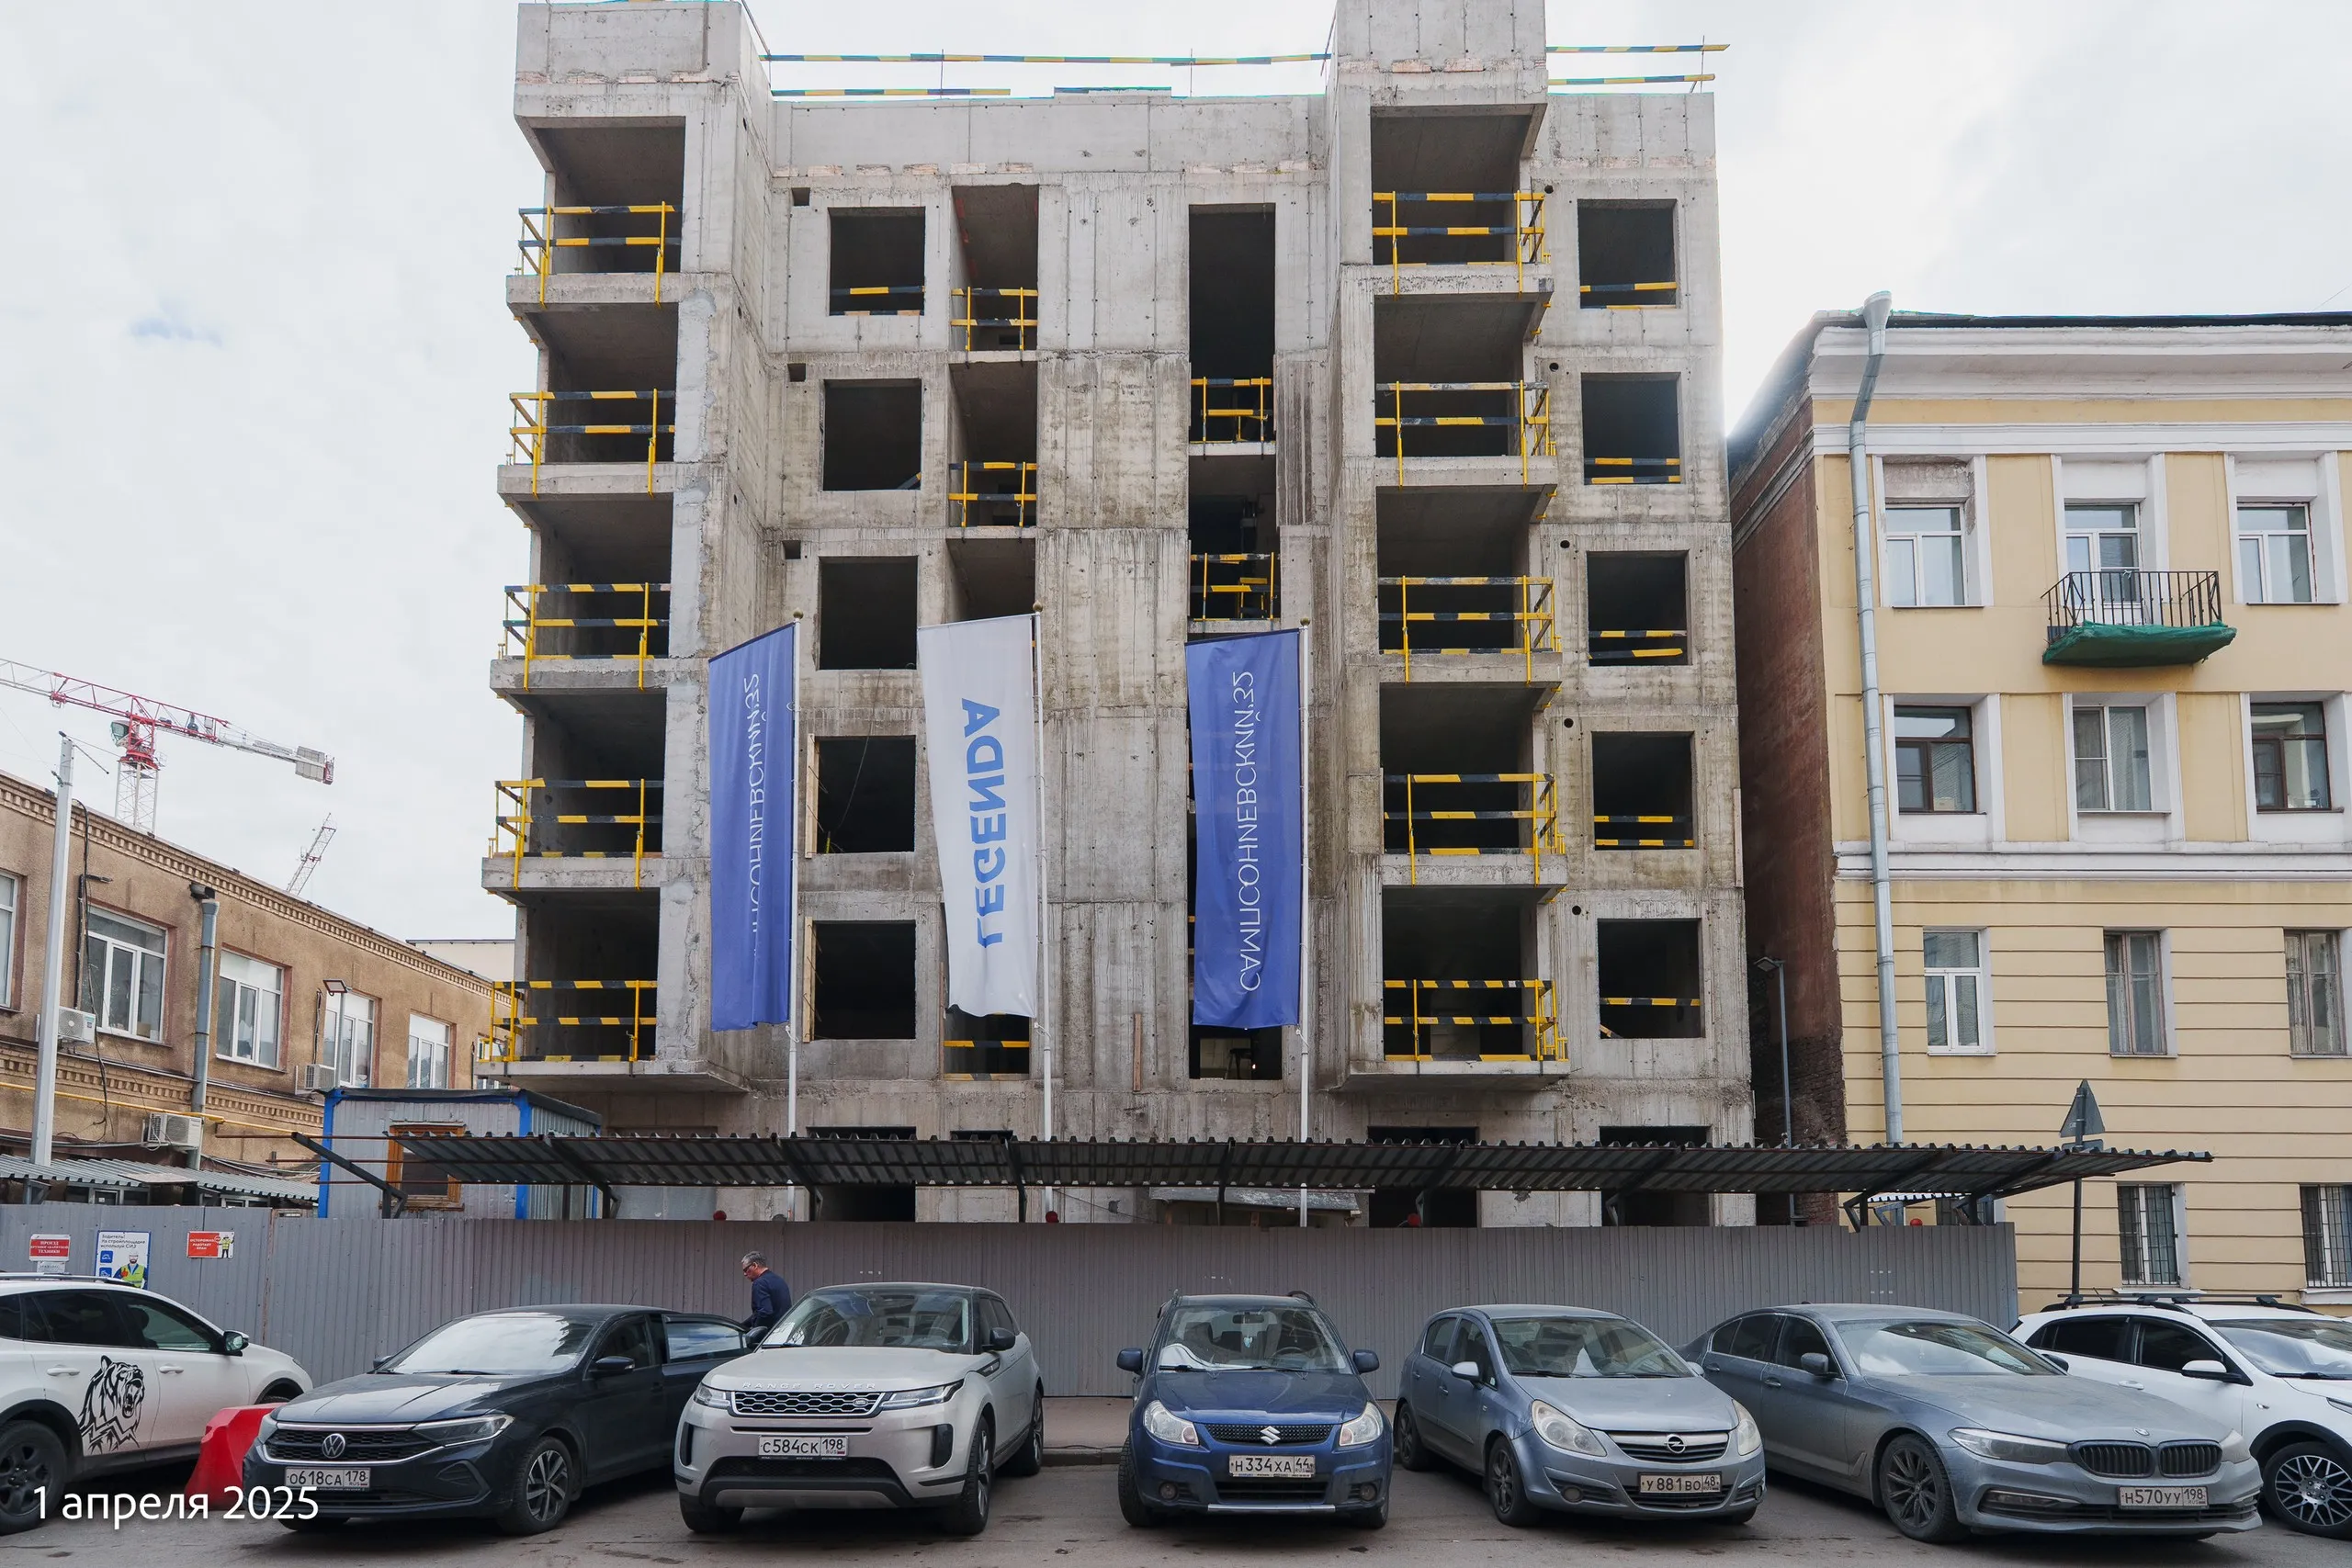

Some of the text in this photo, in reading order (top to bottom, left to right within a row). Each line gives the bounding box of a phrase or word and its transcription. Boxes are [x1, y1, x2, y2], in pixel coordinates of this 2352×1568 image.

[742, 1382, 876, 1390] RANGE ROVER
[763, 1438, 843, 1454] С584СК 198
[1235, 1457, 1309, 1472] Н334ХА 44
[289, 1470, 366, 1485] О618СА 178
[1646, 1476, 1715, 1491] У881ВО 48
[2124, 1488, 2203, 1504] Н570УУ 198
